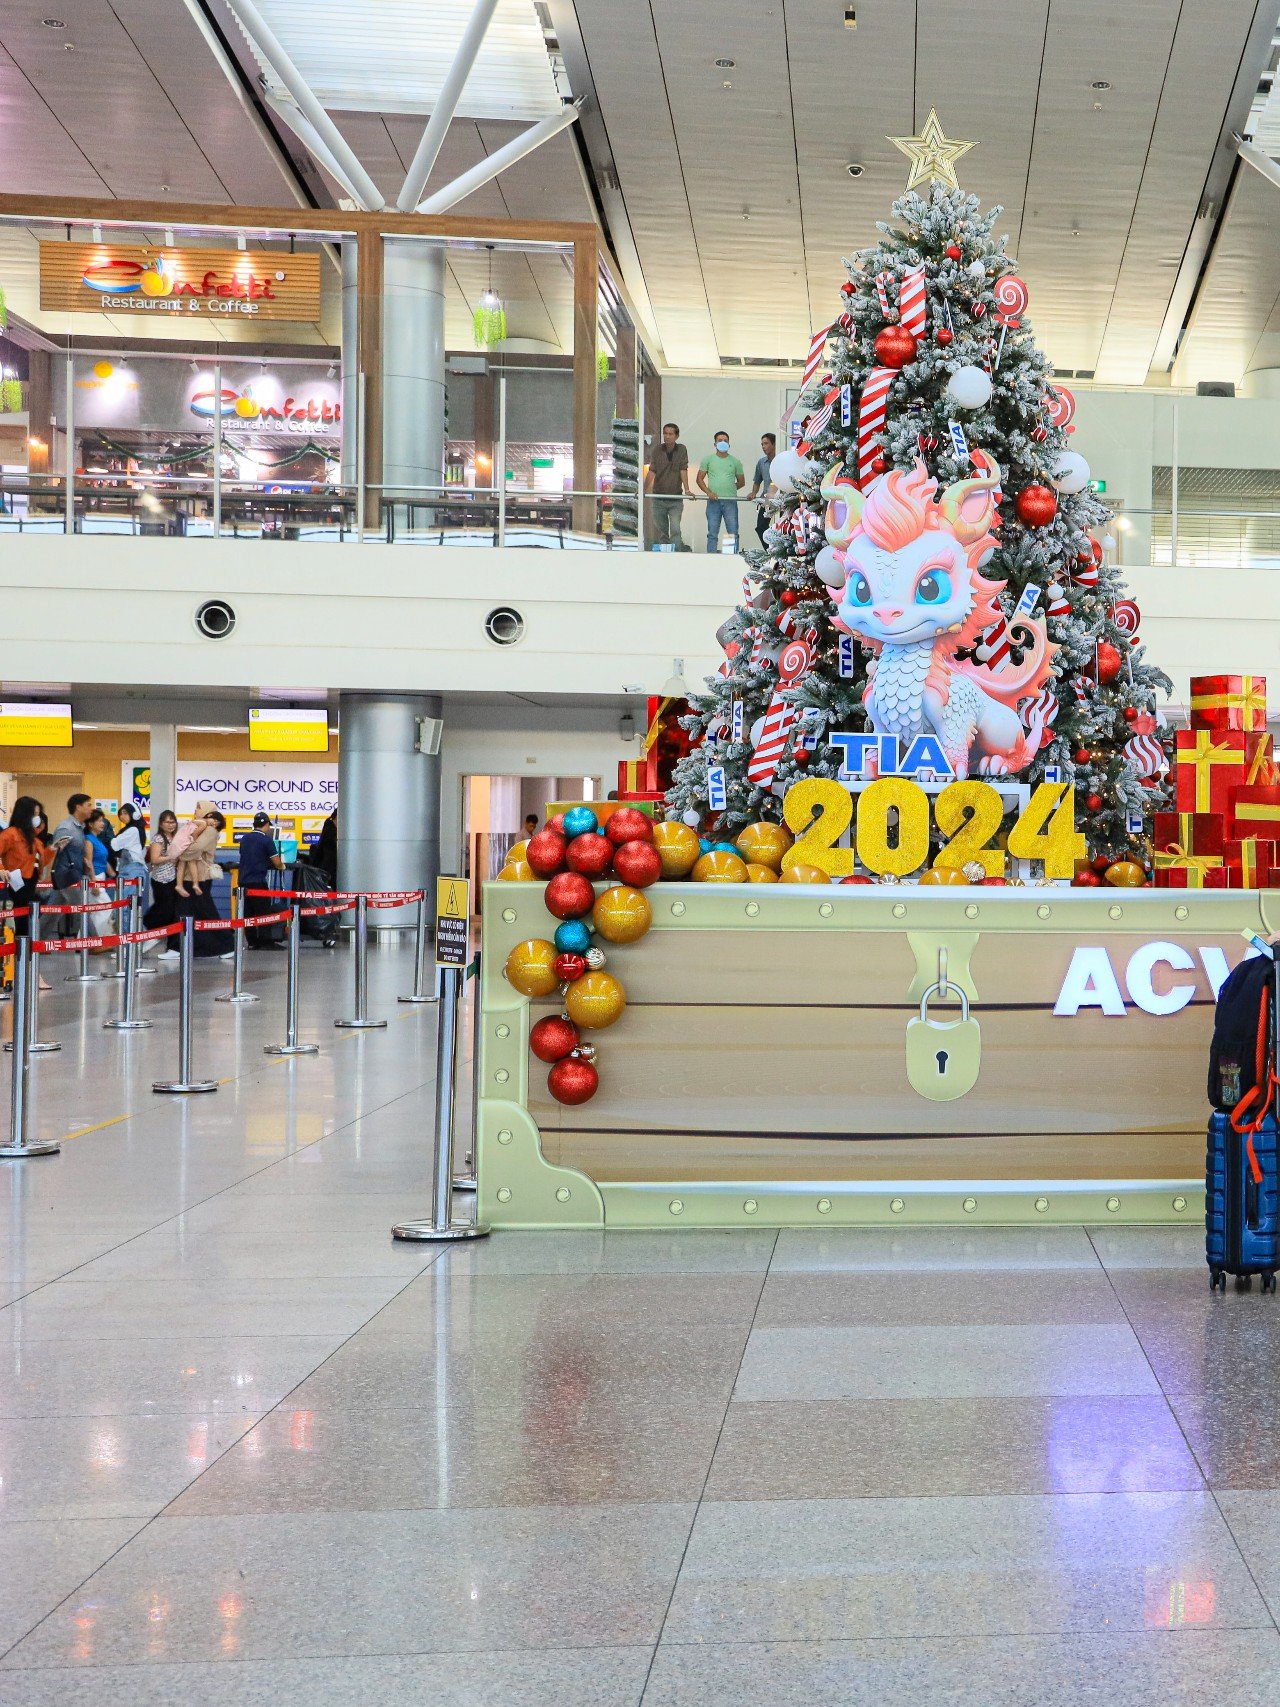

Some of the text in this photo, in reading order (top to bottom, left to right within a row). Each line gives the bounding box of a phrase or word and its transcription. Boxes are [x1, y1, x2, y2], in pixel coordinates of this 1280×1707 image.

[101, 295, 259, 314] Restaurant & Coffee
[206, 417, 329, 433] Rstaurant & Coffee
[952, 425, 967, 457] TIA
[1018, 589, 1038, 612] IA
[841, 636, 852, 675] TIA
[829, 732, 955, 777] TIA
[176, 778, 239, 793] SAIGON
[245, 779, 314, 794] GROUND
[712, 769, 724, 808] TIA
[257, 801, 265, 811] &
[268, 801, 306, 811] EXCESS
[781, 778, 1088, 880] 2024
